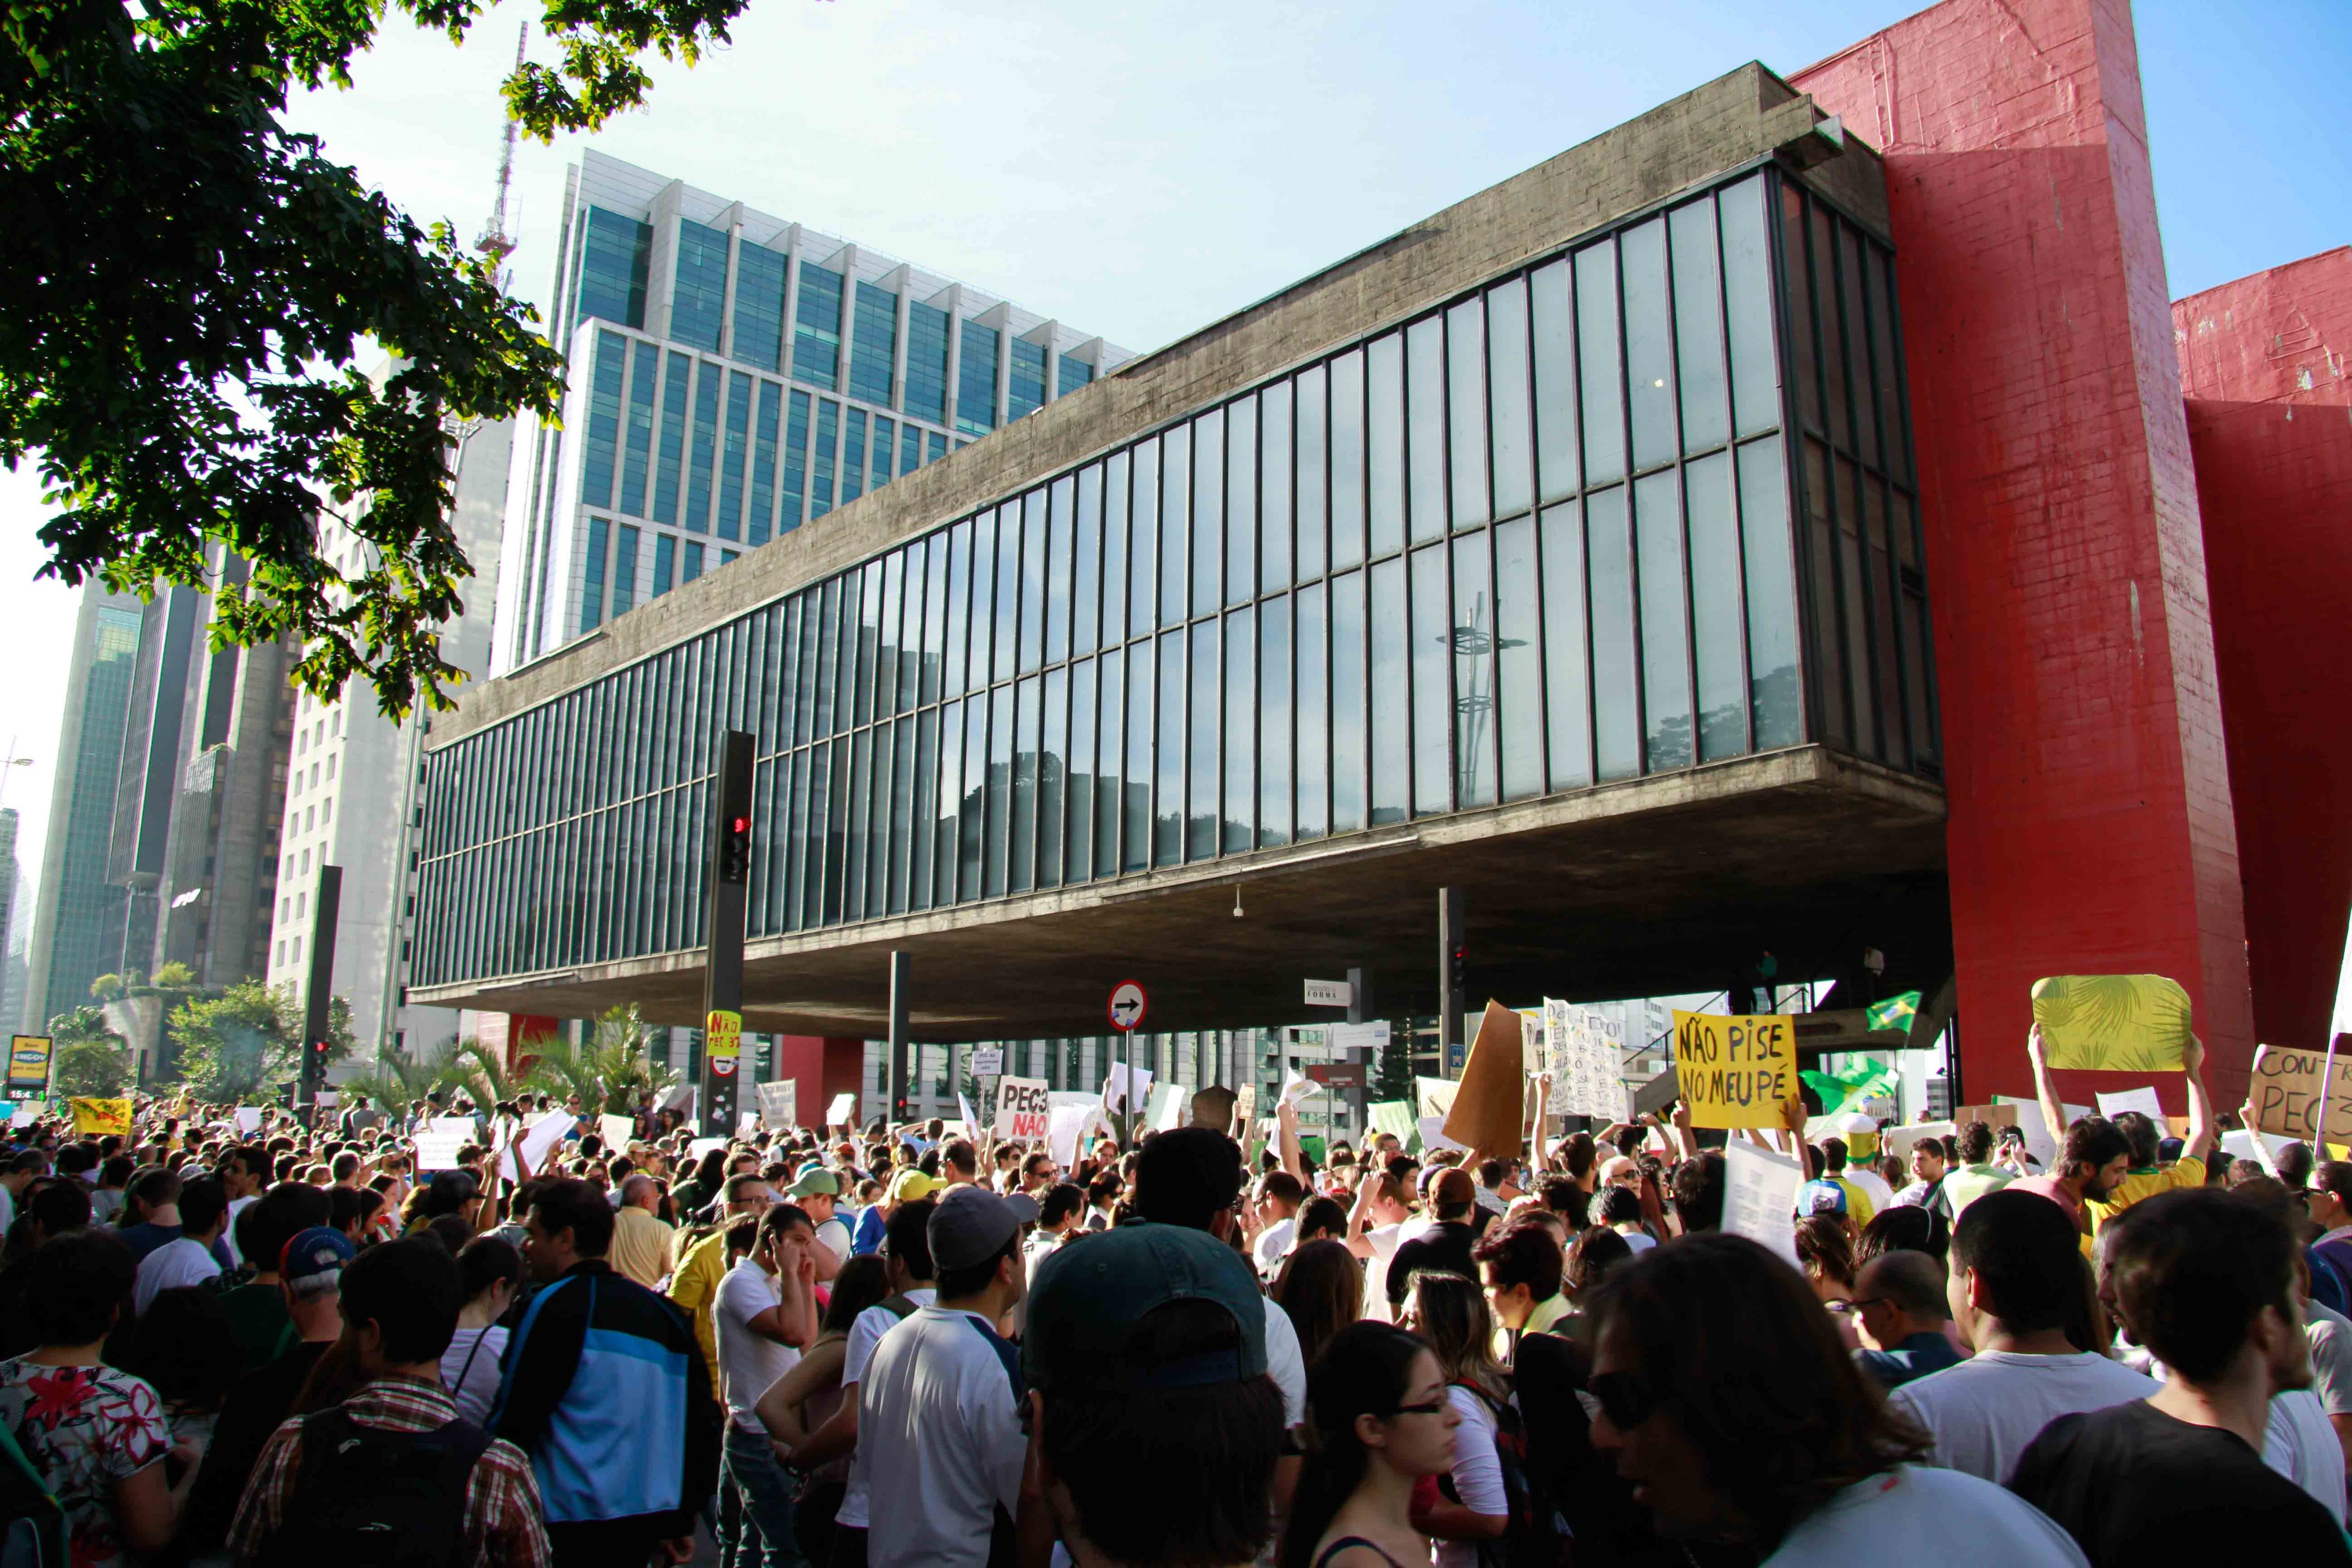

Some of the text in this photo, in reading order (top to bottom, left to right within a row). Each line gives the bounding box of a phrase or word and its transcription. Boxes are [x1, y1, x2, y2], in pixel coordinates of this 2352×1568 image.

[710, 1012, 738, 1034] NÃO
[729, 1036, 740, 1049] 37
[1679, 1016, 1717, 1065] NÃO
[1708, 1069, 1752, 1106] MEU
[1756, 1063, 1788, 1101] PÉ
[1012, 1111, 1047, 1138] NÃO
